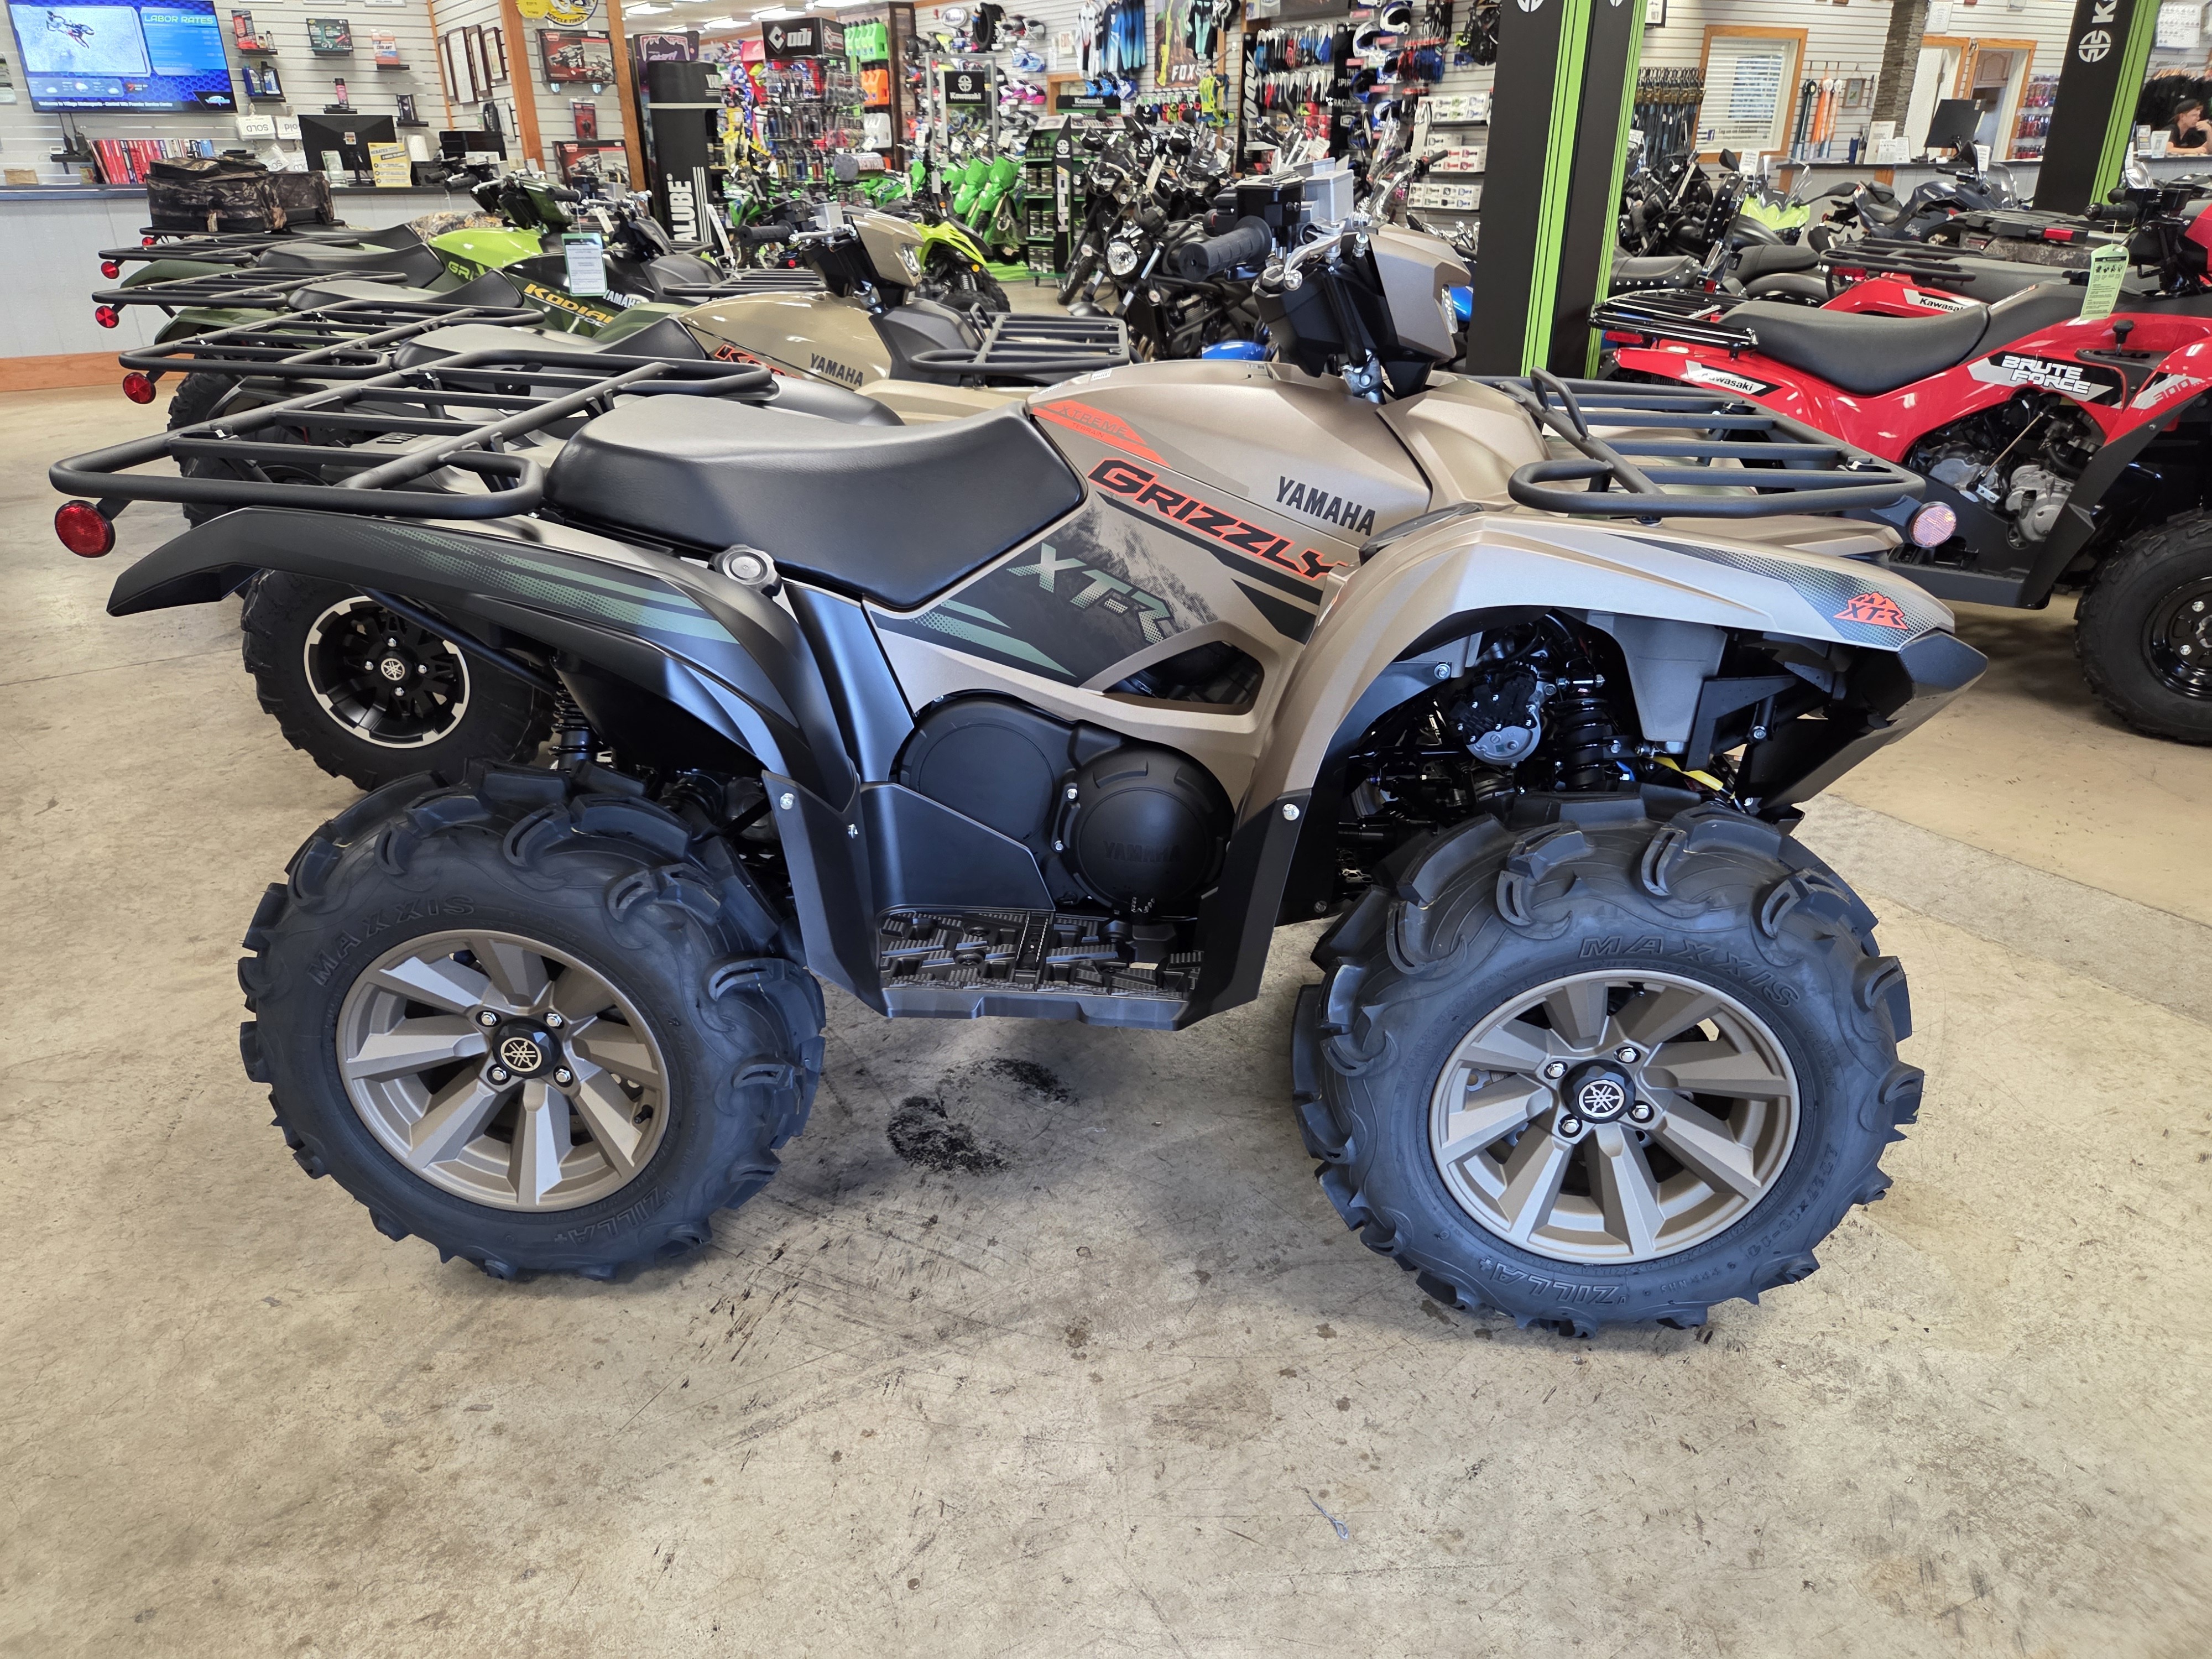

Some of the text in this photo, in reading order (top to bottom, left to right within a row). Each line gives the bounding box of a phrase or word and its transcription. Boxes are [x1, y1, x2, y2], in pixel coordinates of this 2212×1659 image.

[181, 16, 213, 24] RATES
[569, 15, 584, 23] TIRES
[1171, 64, 1196, 82] FOX
[1338, 78, 1352, 87] SPIR
[667, 180, 697, 241] ALUBE
[603, 289, 641, 309] YAMAH
[1919, 298, 1964, 312] Kawasa
[810, 353, 863, 387] YAMAHA
[2001, 356, 2083, 380] BRUTE
[1700, 369, 1754, 392] wasaki
[2010, 369, 2091, 394] FORCE
[2153, 378, 2193, 401] 300
[1059, 405, 1129, 437] XTREME
[1072, 422, 1105, 438] TERRAIN
[1276, 476, 1376, 536] YAMAHA
[1088, 457, 1349, 581] GRIZZLY
[1845, 603, 1905, 627] XT-R
[1103, 841, 1181, 863] YAMAHA
[307, 894, 474, 988] MAXXIS
[1578, 935, 1800, 1008] MAXXIS
